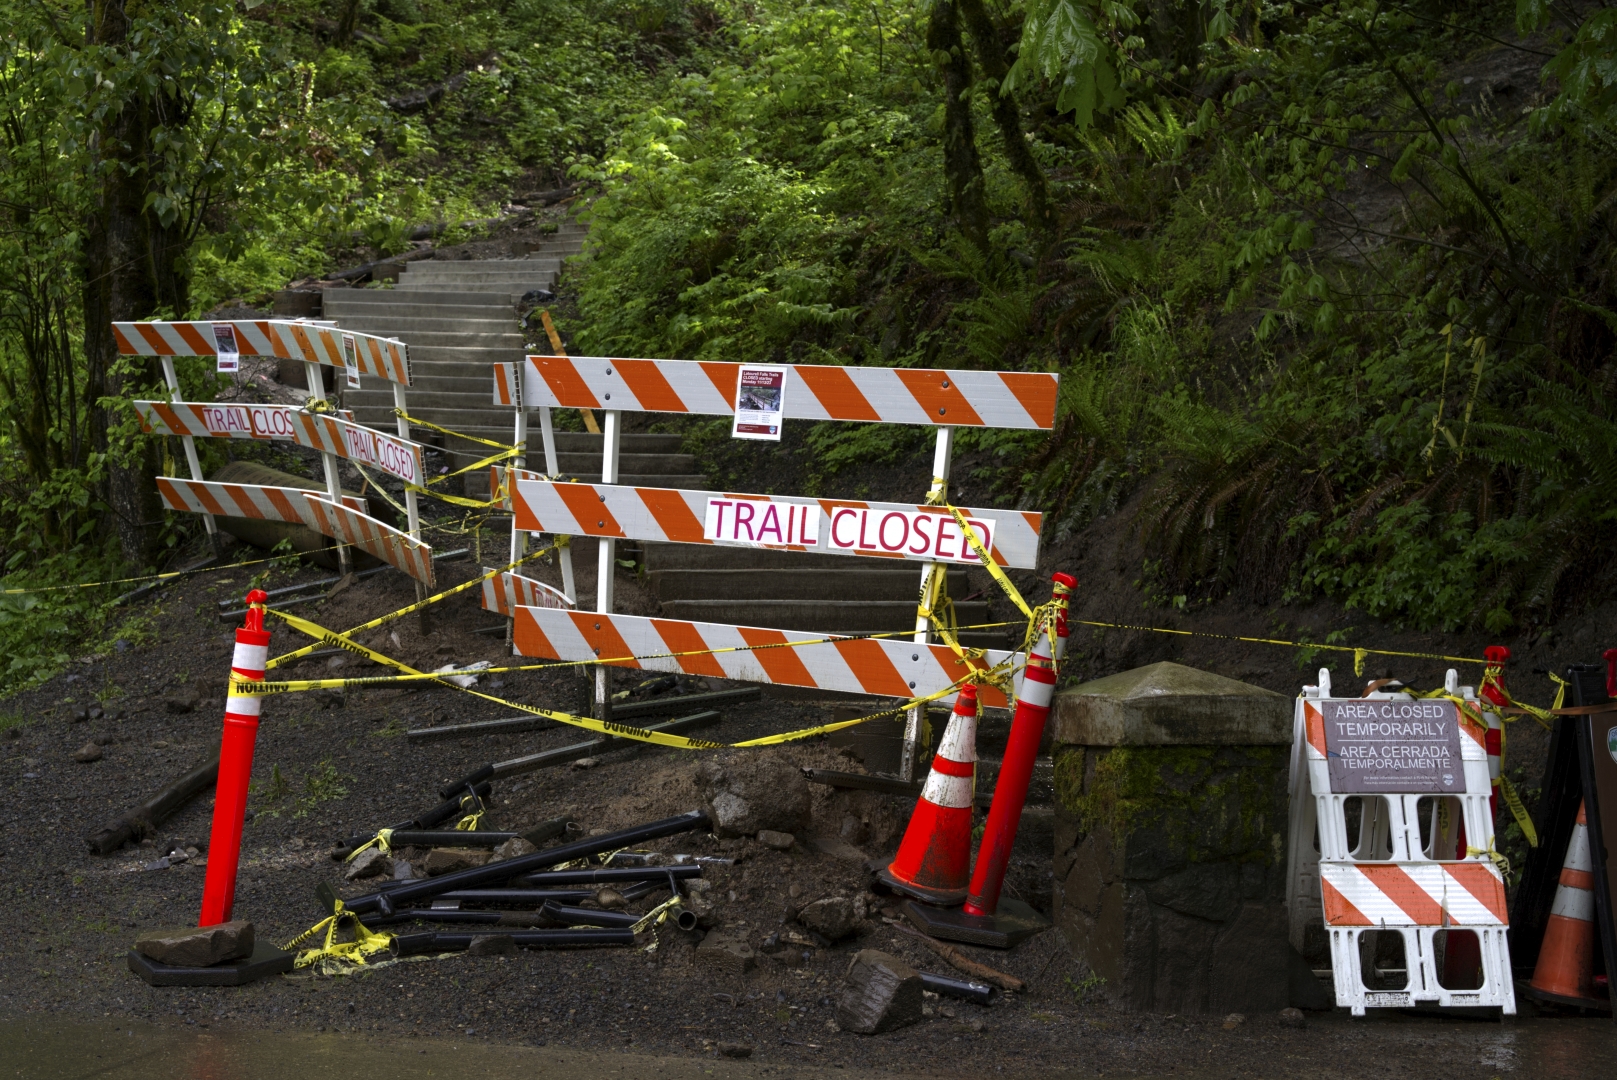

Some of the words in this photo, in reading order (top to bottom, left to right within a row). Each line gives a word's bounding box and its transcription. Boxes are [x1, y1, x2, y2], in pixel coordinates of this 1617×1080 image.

[203, 407, 250, 432] TRAIL
[253, 408, 294, 436] CLOS
[345, 426, 376, 463] TRAIL
[375, 436, 414, 481] CLOSED
[710, 500, 817, 545] TRAIL
[831, 508, 991, 561] CLOSED
[1335, 705, 1378, 718] AREA
[1381, 705, 1444, 719] CLOSED
[1336, 722, 1446, 736] TEMPORARILY
[1340, 746, 1378, 758] AREA
[1381, 746, 1450, 758] CERRADA
[1341, 758, 1451, 769] TEMPORALMENTE
